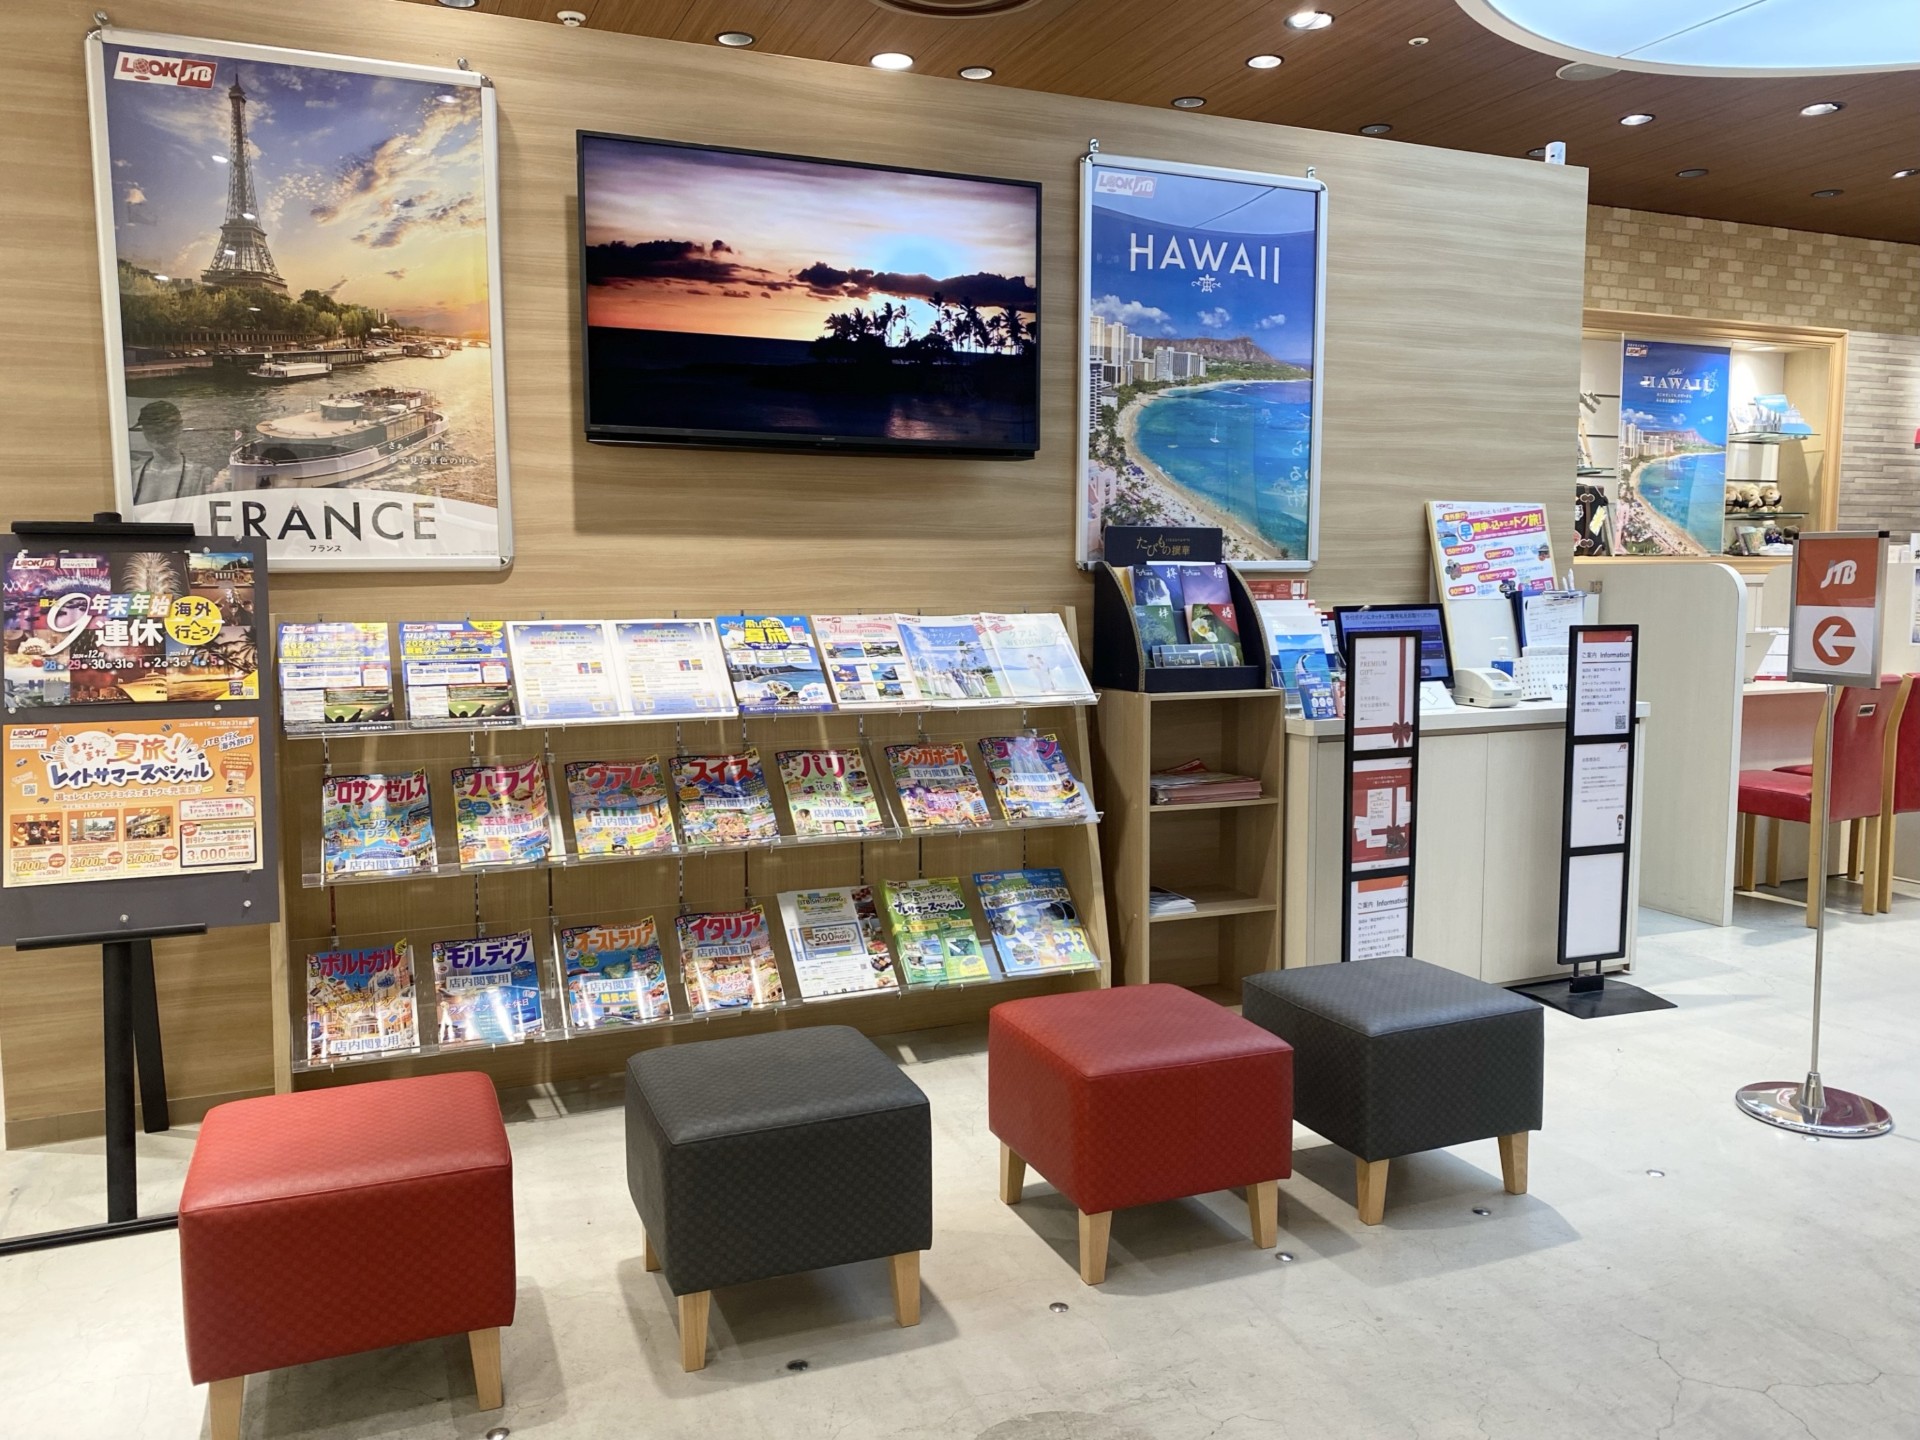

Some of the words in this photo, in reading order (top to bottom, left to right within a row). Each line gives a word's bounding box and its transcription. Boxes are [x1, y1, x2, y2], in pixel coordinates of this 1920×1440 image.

[120, 57, 179, 79] LOOK
[180, 63, 212, 82] JTB
[1099, 175, 1134, 190] LOOK
[1130, 232, 1280, 284] HAWAII
[1641, 375, 1712, 392] HAWAII
[209, 501, 437, 541] FRANCE
[309, 544, 342, 552] フランス
[1820, 559, 1857, 589] JTB
[90, 593, 171, 617] 年末年始
[175, 602, 211, 616] 海外
[47, 592, 92, 656] 9
[96, 619, 164, 647] 連休
[175, 626, 216, 641] 行こう!
[1006, 637, 1049, 646] WEDDING
[1360, 660, 1387, 668] PREMIUM
[1581, 651, 1597, 659] ご案内
[106, 736, 182, 765] 夏旅!
[221, 736, 252, 750] 海外旅行
[898, 747, 967, 766] シンガポール
[50, 762, 209, 786] レイトサマースペシャル
[689, 758, 755, 784] スイス
[801, 754, 846, 778] パリ
[914, 767, 960, 778] 店内閲覧用
[468, 764, 537, 797] ハワイ
[585, 766, 656, 789] グアム
[816, 780, 842, 791] 花の都
[337, 775, 426, 803] ロサンゼルス
[83, 811, 104, 819] ハワイ
[595, 815, 652, 827] 店内閲覧用
[813, 808, 864, 817] 店内閲覧用
[894, 900, 963, 913] プレサマースペシャル
[1358, 901, 1373, 910] ご案内
[1377, 897, 1408, 908] Information
[690, 913, 760, 940] イタリア
[576, 922, 654, 952] オーストラリア
[447, 935, 530, 969] モルディブ
[698, 944, 749, 957] 店内閲覧用
[320, 947, 401, 976] ポルトガル
[449, 974, 509, 988] 店内閲覧用
[335, 1035, 399, 1052] 店内閲覧用
